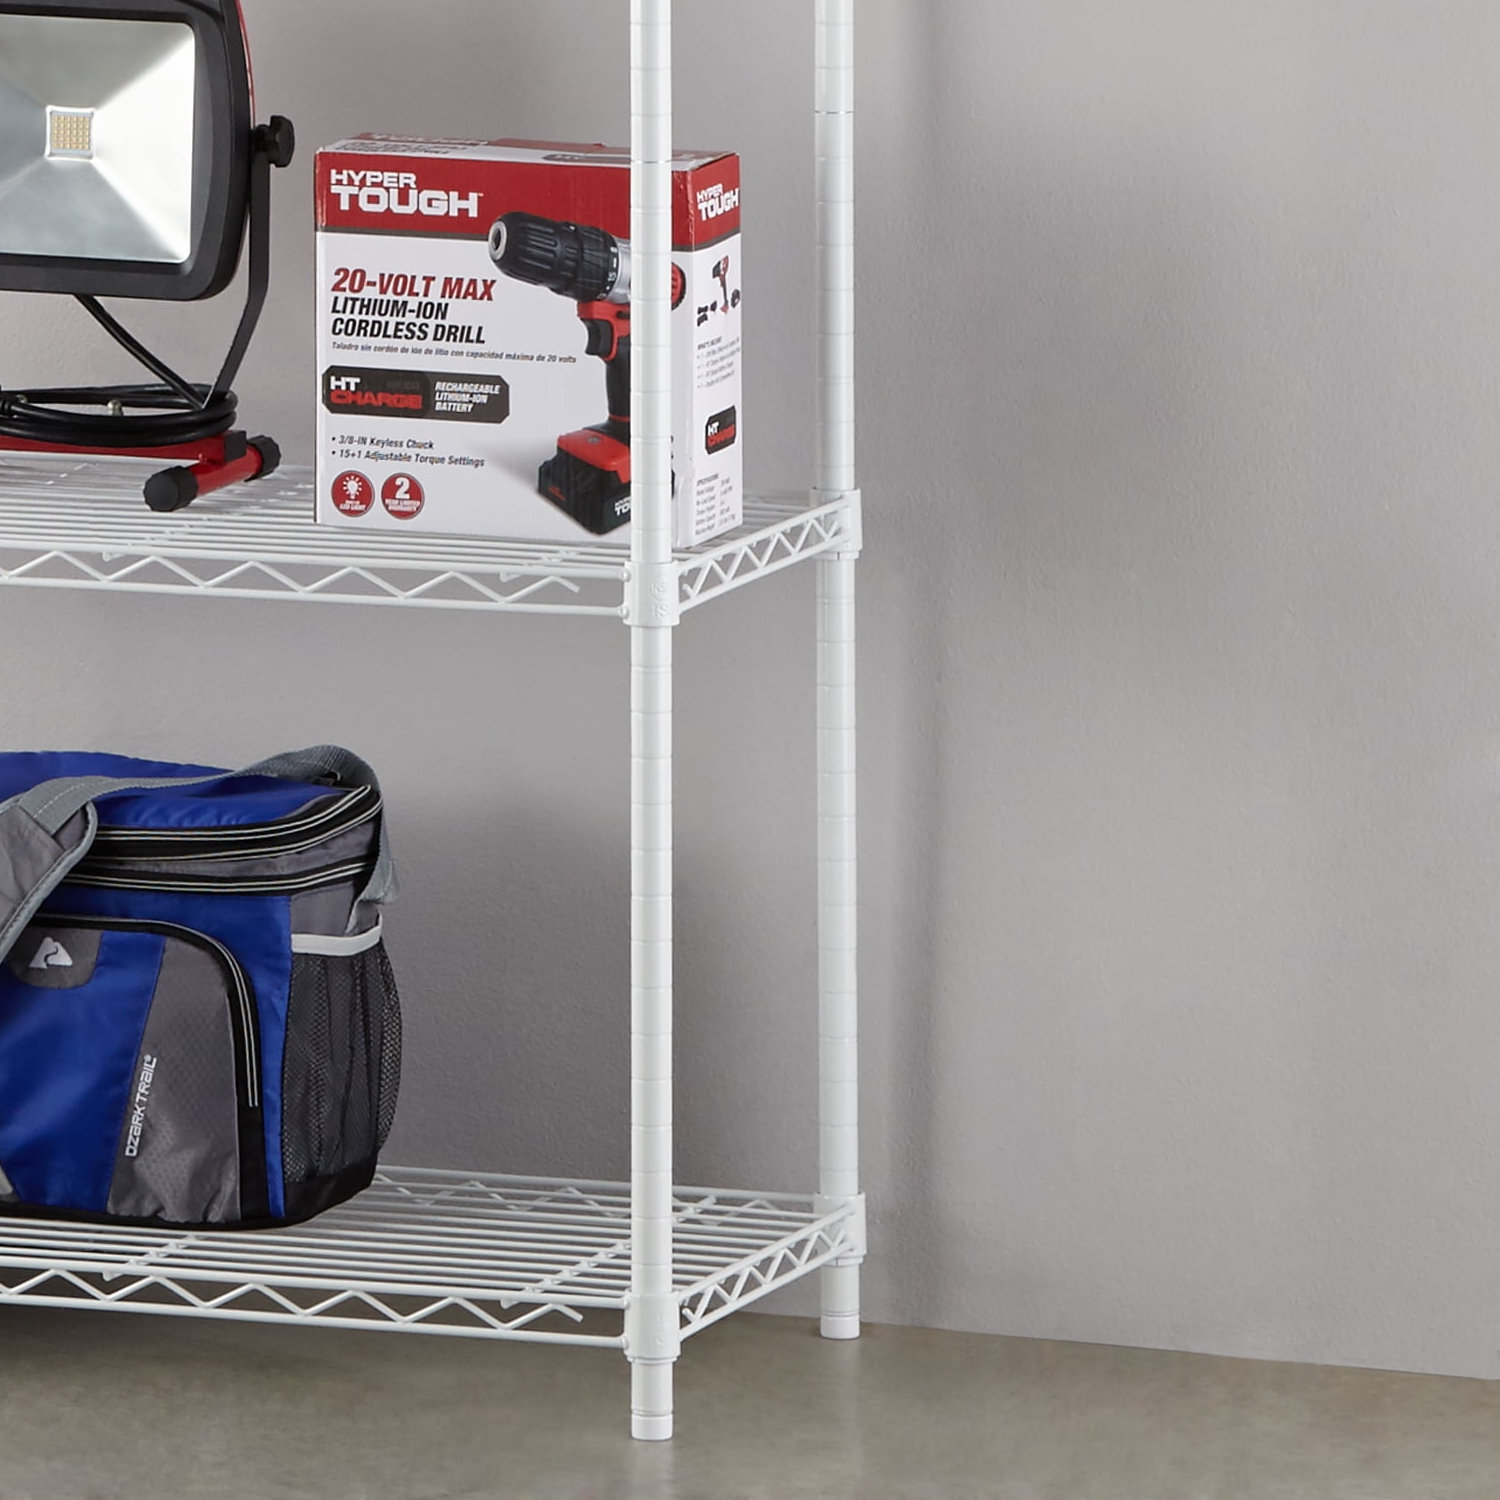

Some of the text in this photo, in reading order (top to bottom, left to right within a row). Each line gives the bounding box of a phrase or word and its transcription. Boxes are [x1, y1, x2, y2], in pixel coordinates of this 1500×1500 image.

[330, 169, 416, 188] HYPER
[330, 185, 478, 218] TOUGH
[697, 188, 739, 221] TOUGH
[331, 267, 497, 301] 20-VOLT MAX
[331, 296, 449, 320] LITHIUM-ION
[331, 317, 485, 344] CORDLESS DRILL
[332, 341, 359, 351] Taladro
[465, 350, 503, 359] capacidad
[547, 354, 557, 362] 20
[330, 375, 360, 391] HT
[435, 381, 501, 394] RECHARGEABLE
[330, 390, 422, 409] CHARGE
[435, 392, 488, 404] LITHIUM-ION
[435, 401, 474, 412] BATTERY
[339, 435, 435, 449] 3/8-IN Keyless Chuck
[339, 449, 485, 468] 15+1 Adjustable Torque Settings
[394, 476, 411, 500] 2
